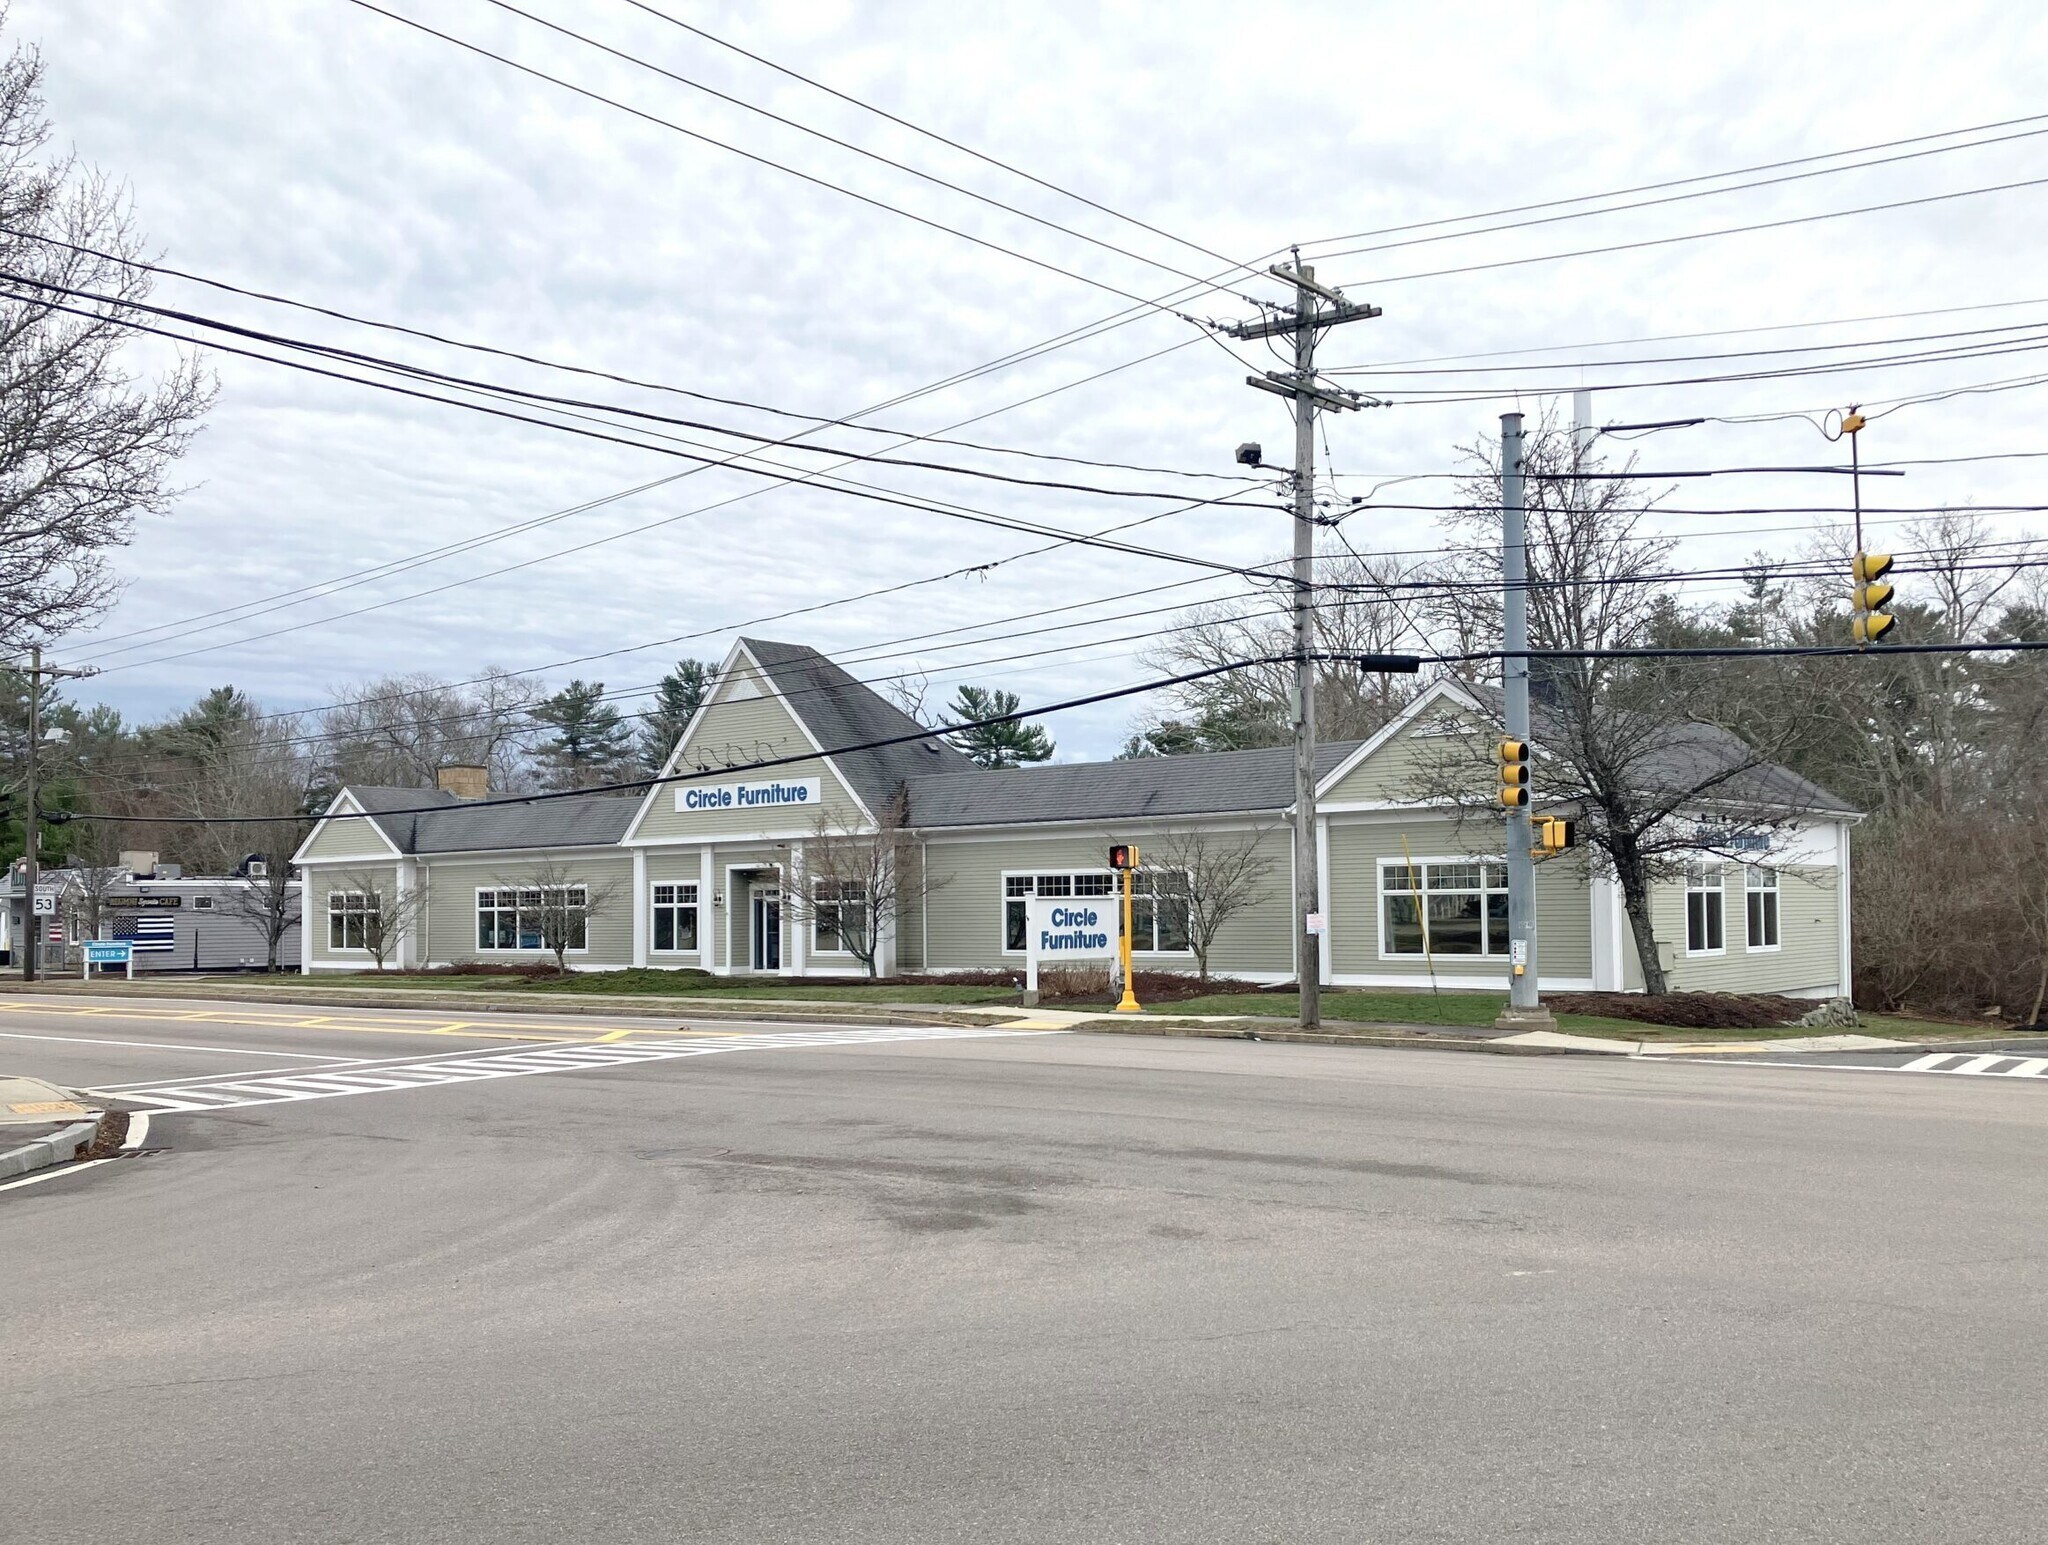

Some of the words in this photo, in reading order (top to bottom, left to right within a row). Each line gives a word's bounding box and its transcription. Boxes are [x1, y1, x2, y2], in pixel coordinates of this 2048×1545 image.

[685, 788, 732, 809] Circle
[737, 783, 808, 805] Furniture
[35, 898, 53, 910] 53
[1051, 908, 1098, 927] Circle
[1041, 930, 1108, 950] Furniture
[90, 950, 116, 958] ENTER
